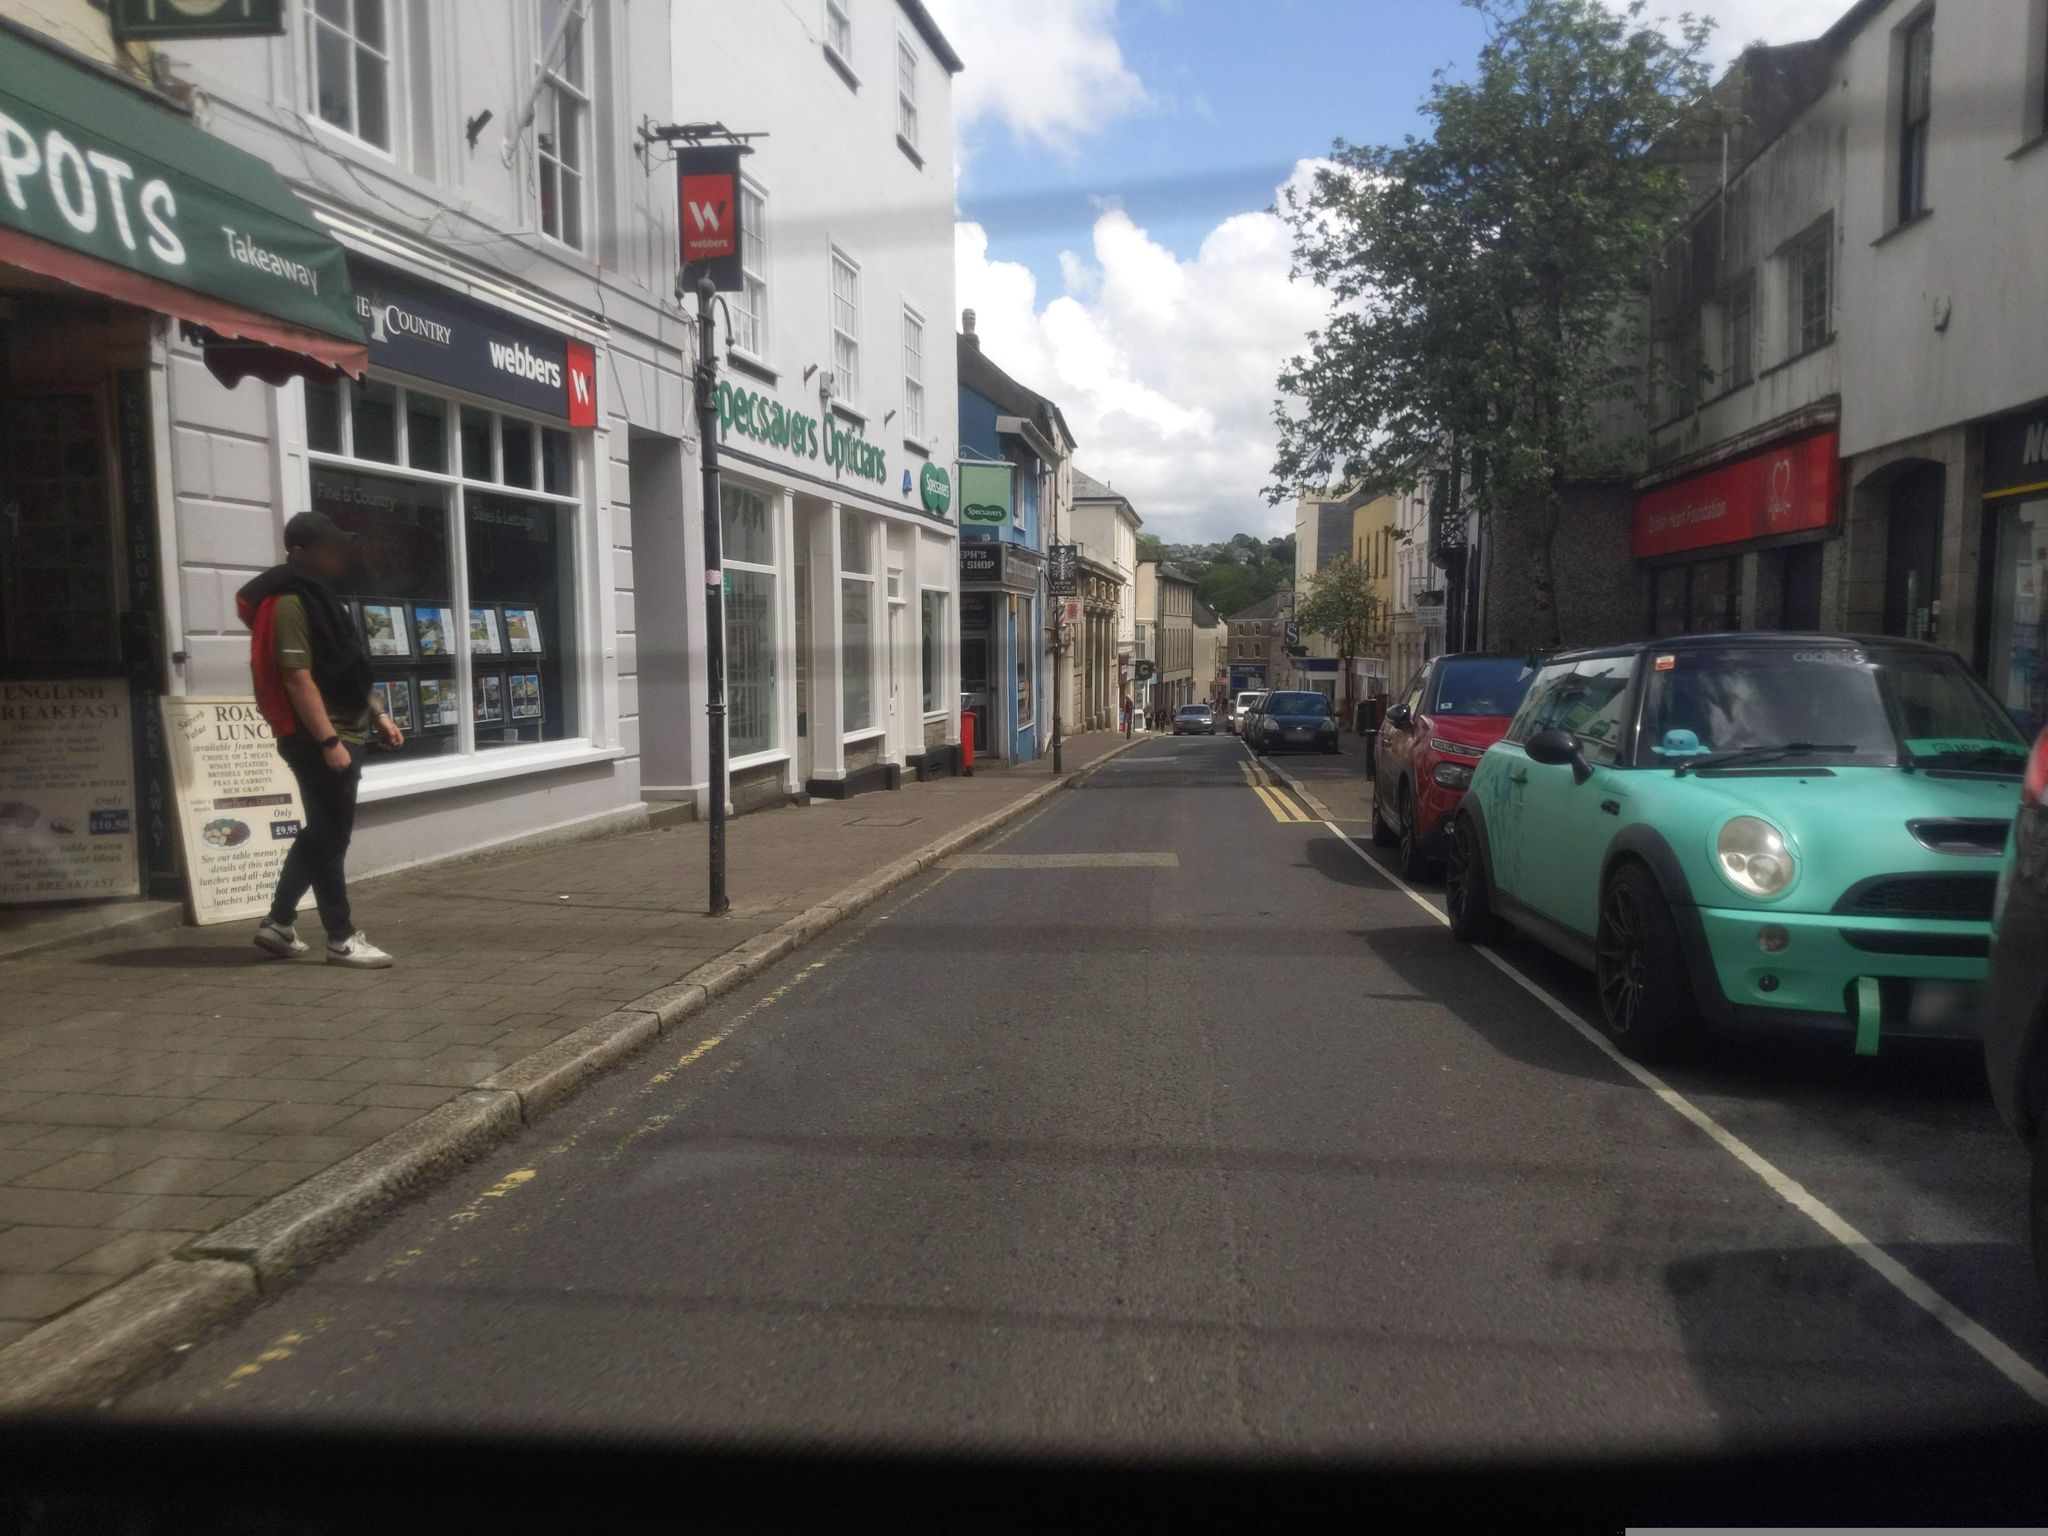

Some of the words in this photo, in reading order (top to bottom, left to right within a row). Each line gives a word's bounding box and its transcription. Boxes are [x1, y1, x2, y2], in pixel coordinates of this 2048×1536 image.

[690, 239, 728, 249] webbers
[221, 226, 318, 297] Takeaway
[489, 340, 562, 389] webbers
[823, 412, 887, 485] Opticians
[926, 474, 950, 498] Specsavers
[967, 507, 1002, 517] Specsavers
[967, 560, 995, 569] SHOP
[193, 742, 231, 753] available
[234, 742, 254, 753] from
[235, 761, 269, 769] POTATOES
[241, 777, 272, 785] CARROTS
[274, 808, 293, 819] Only
[276, 825, 299, 835] £9.95
[201, 855, 215, 864] See
[232, 851, 251, 860] table
[253, 849, 277, 858] menus
[211, 863, 237, 874] details
[238, 861, 247, 872] of
[248, 859, 262, 869] this
[264, 858, 278, 867] and
[200, 876, 229, 887] lunches
[232, 873, 247, 882] and
[248, 870, 275, 880] all-day
[215, 887, 228, 895] hot
[247, 892, 269, 905] jacket
